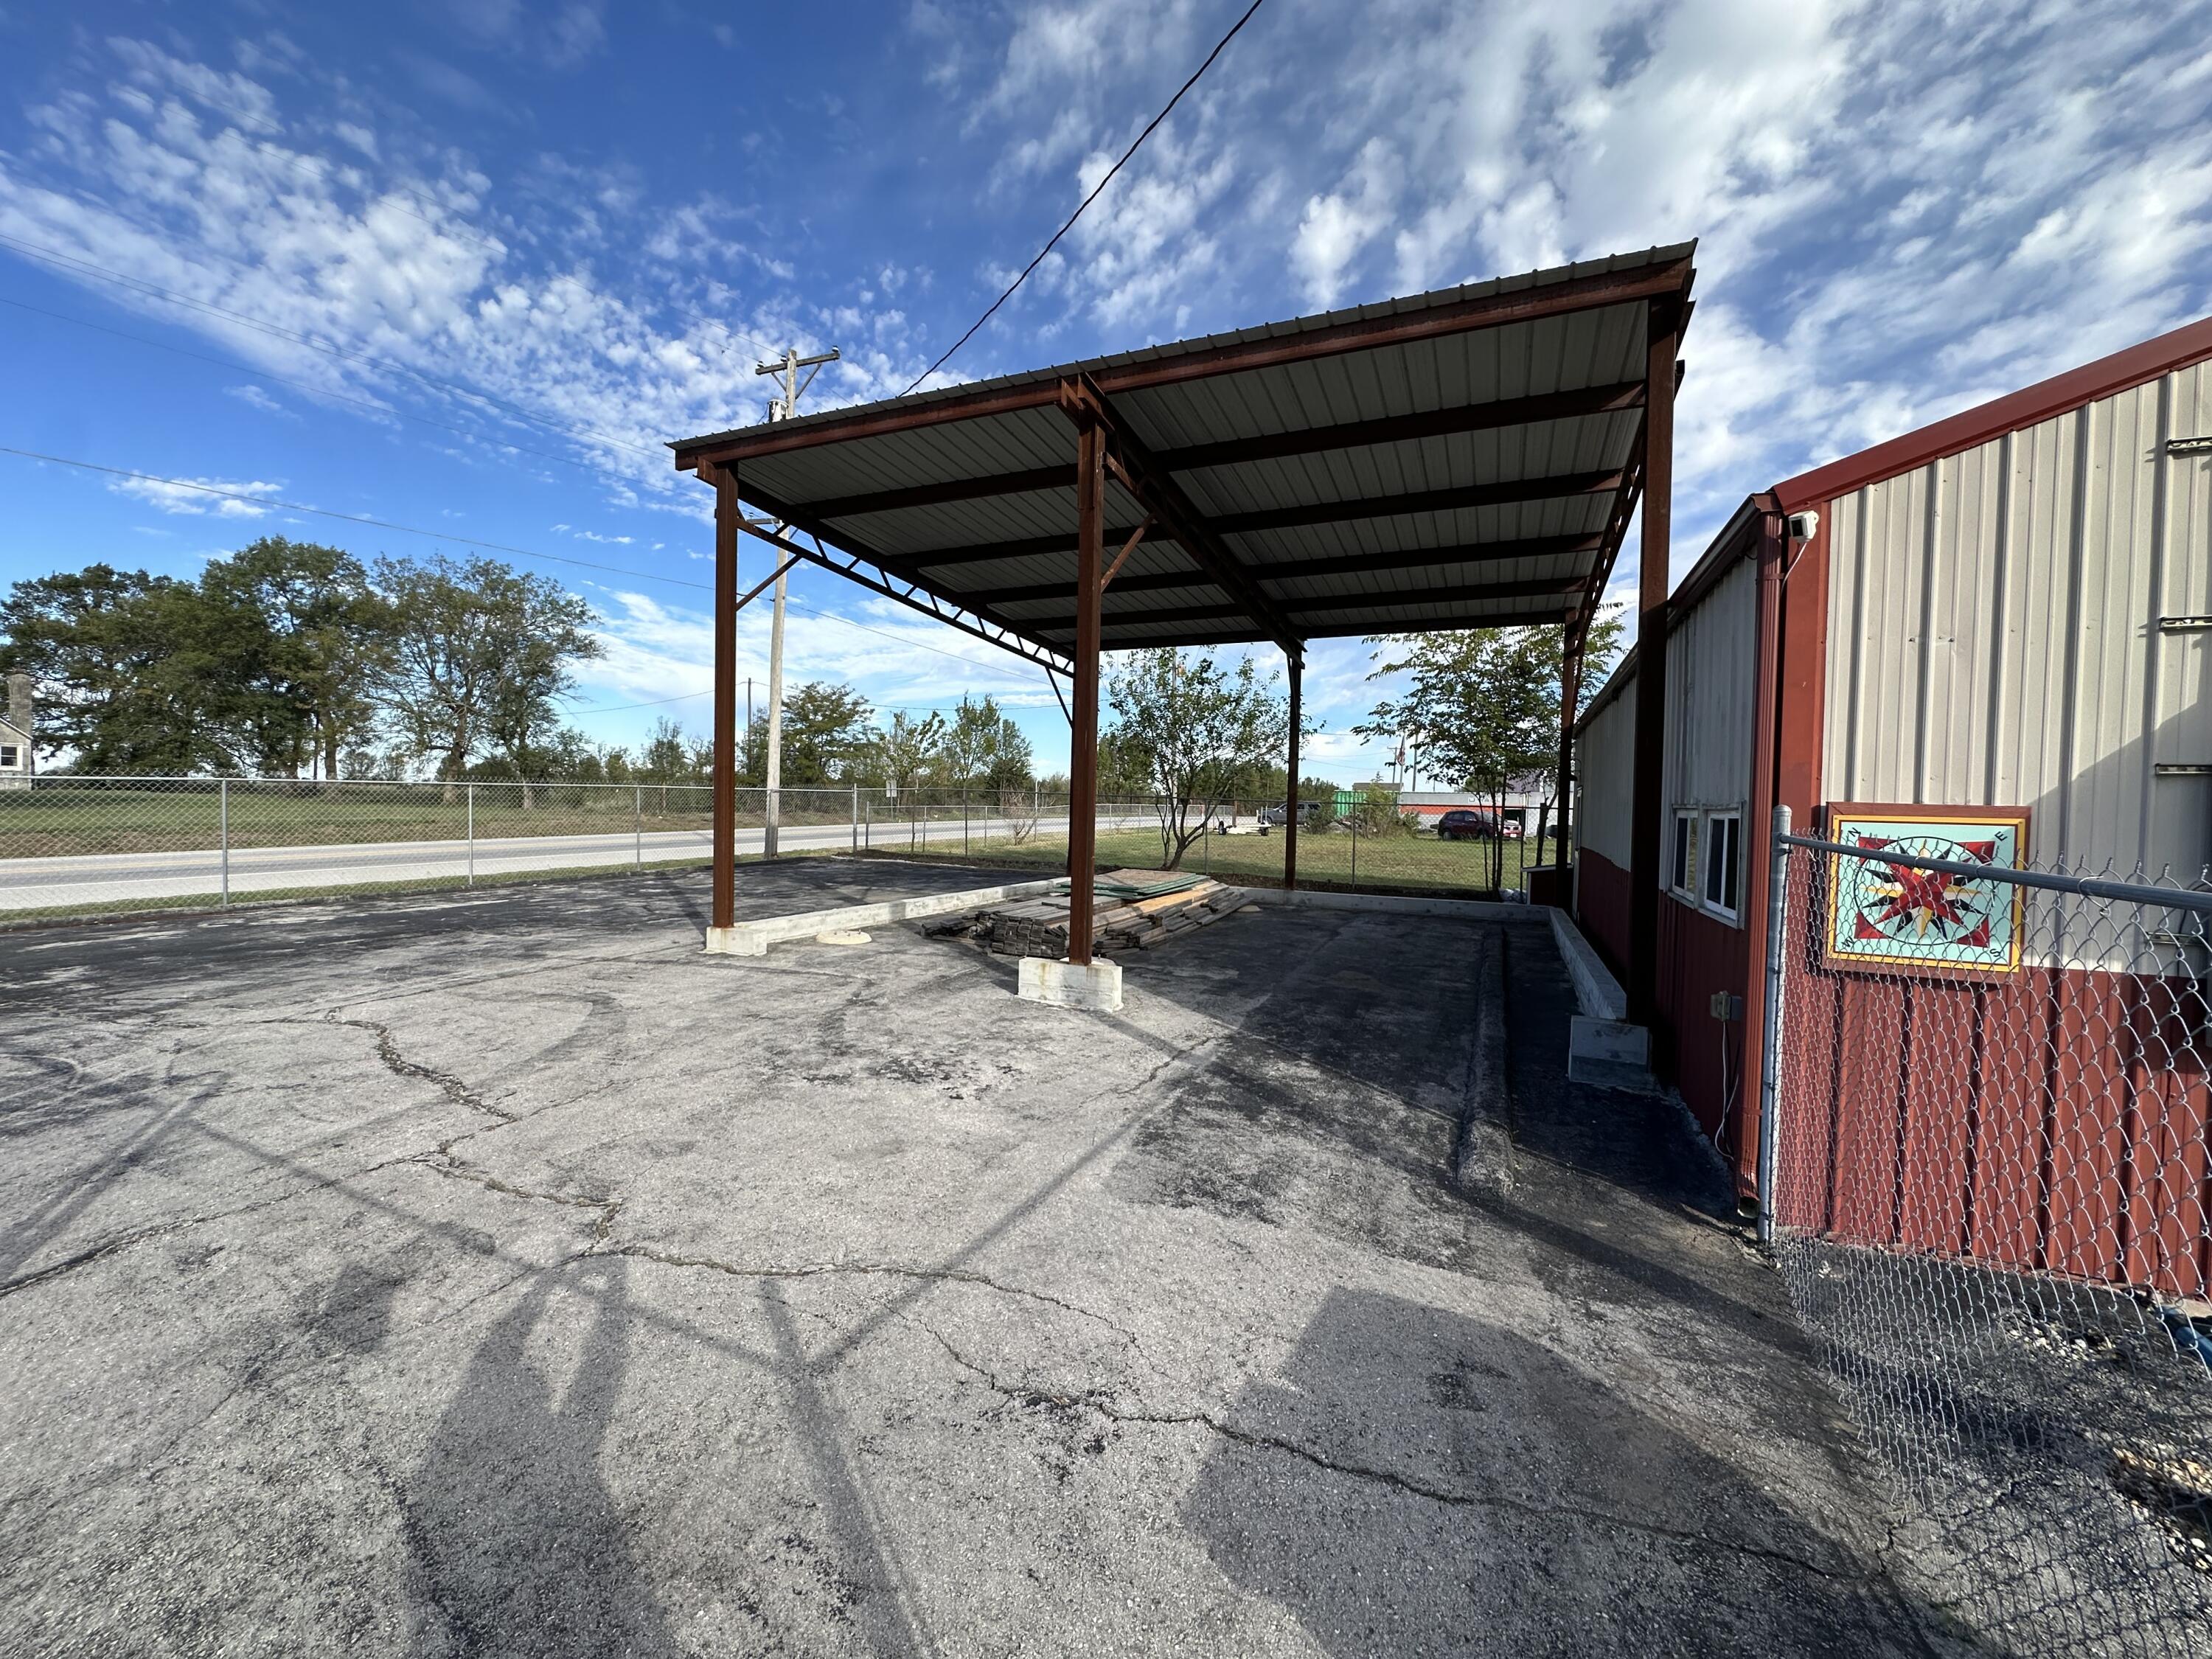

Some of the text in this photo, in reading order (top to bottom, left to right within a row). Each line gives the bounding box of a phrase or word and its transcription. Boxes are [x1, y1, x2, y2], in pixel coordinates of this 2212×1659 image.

[1848, 827, 1861, 837] N
[1994, 831, 2008, 841] E
[1989, 948, 2000, 957] S
